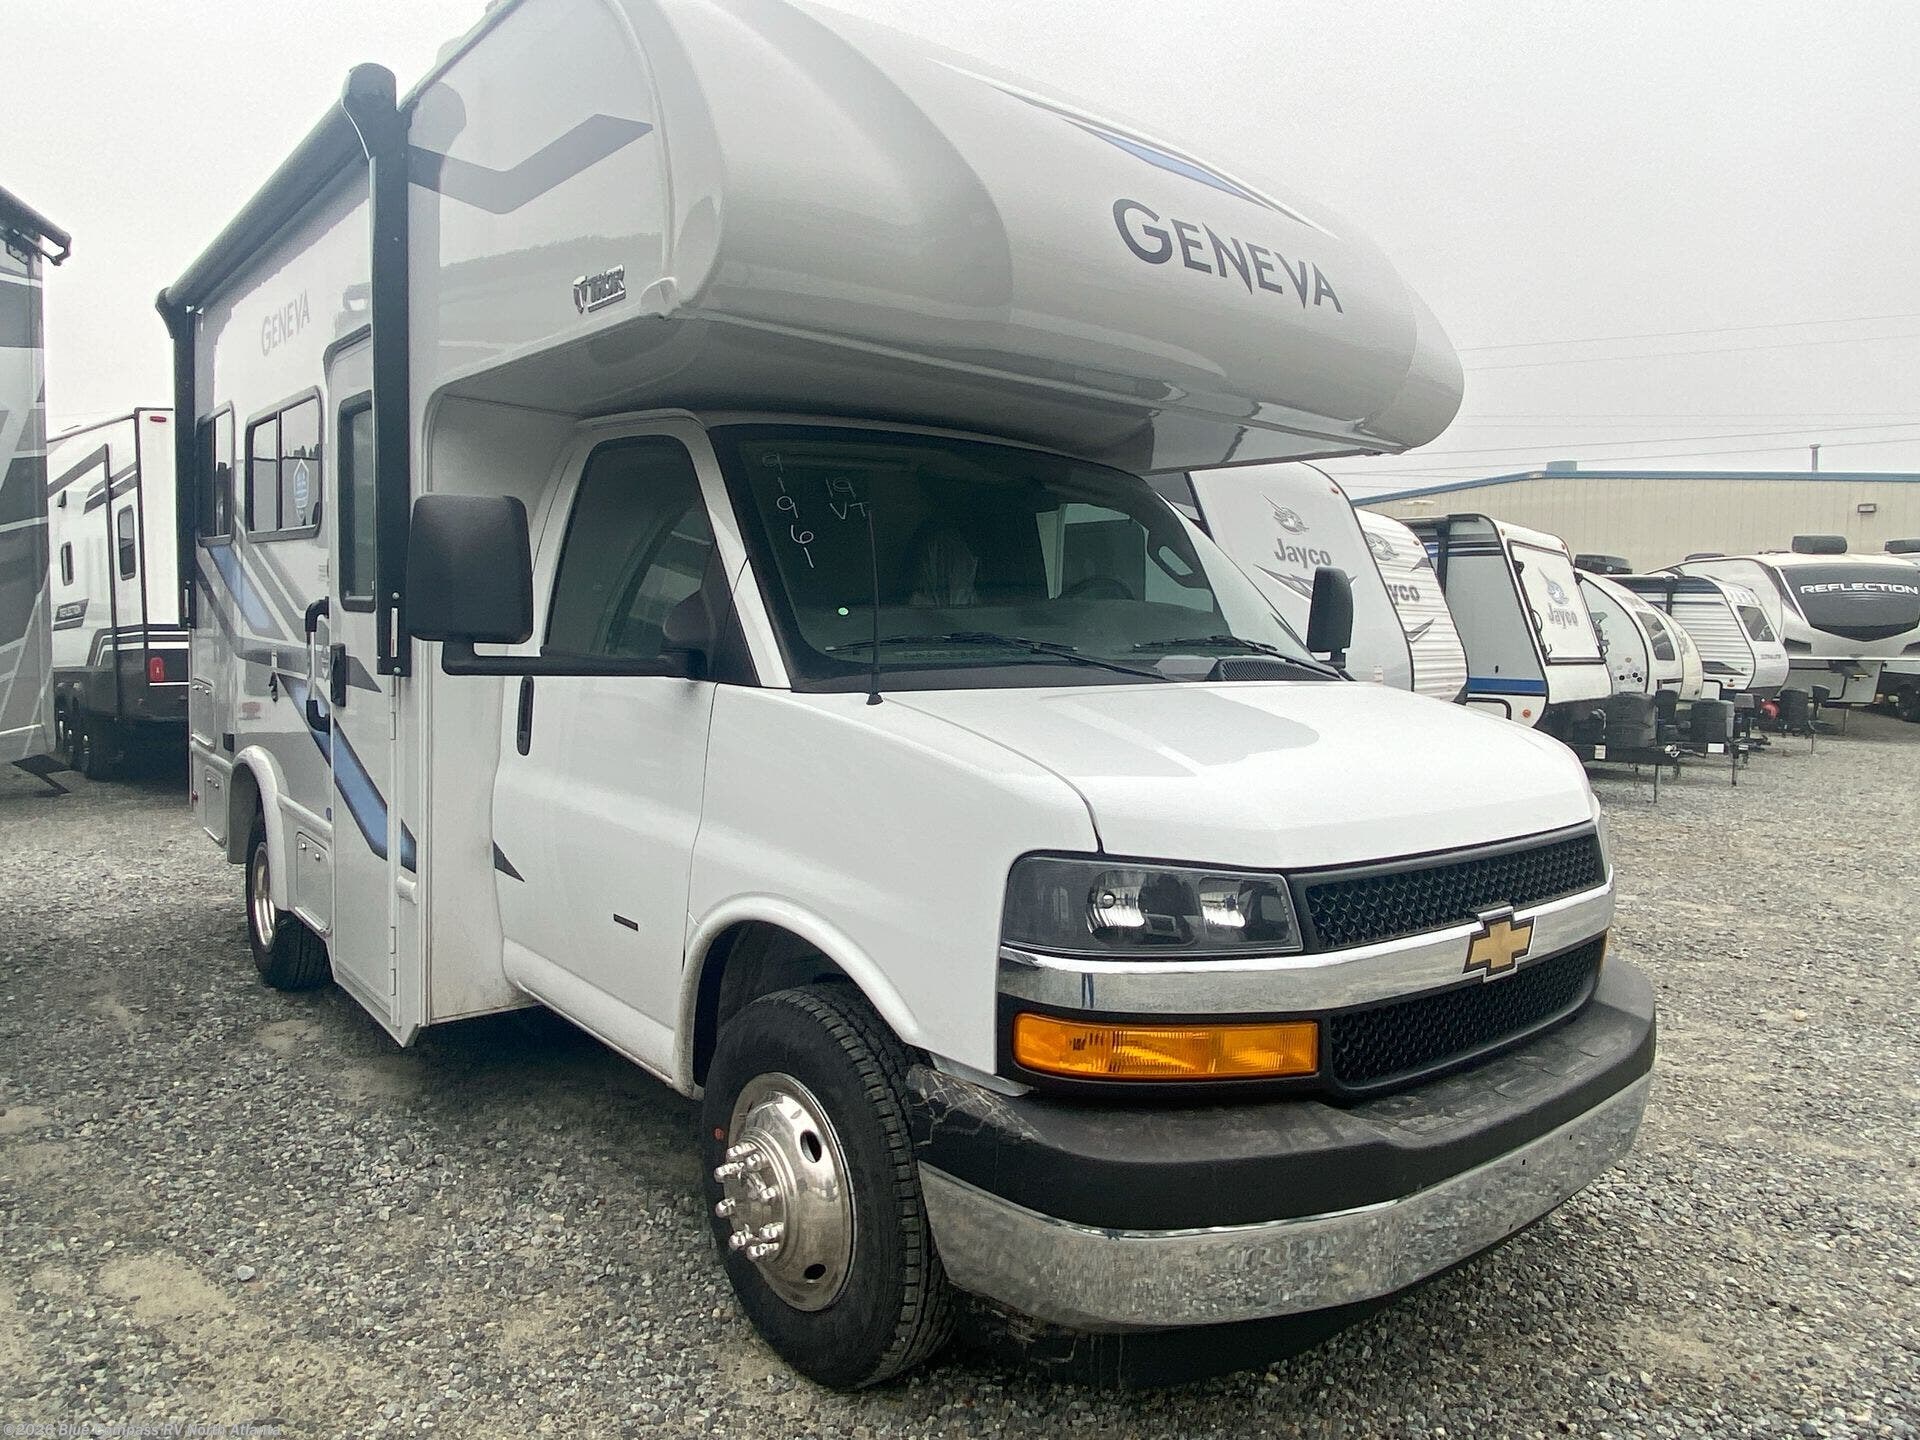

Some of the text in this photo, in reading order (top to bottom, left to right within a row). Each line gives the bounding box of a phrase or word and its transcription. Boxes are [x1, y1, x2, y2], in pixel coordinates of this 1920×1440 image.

[1112, 198, 1344, 314] GENEVA
[261, 288, 310, 357] GENEVA
[1273, 538, 1332, 569] Jayco
[1387, 583, 1421, 606] yco
[1800, 582, 1919, 595] REFLECTION
[1547, 602, 1580, 630] Jayco
